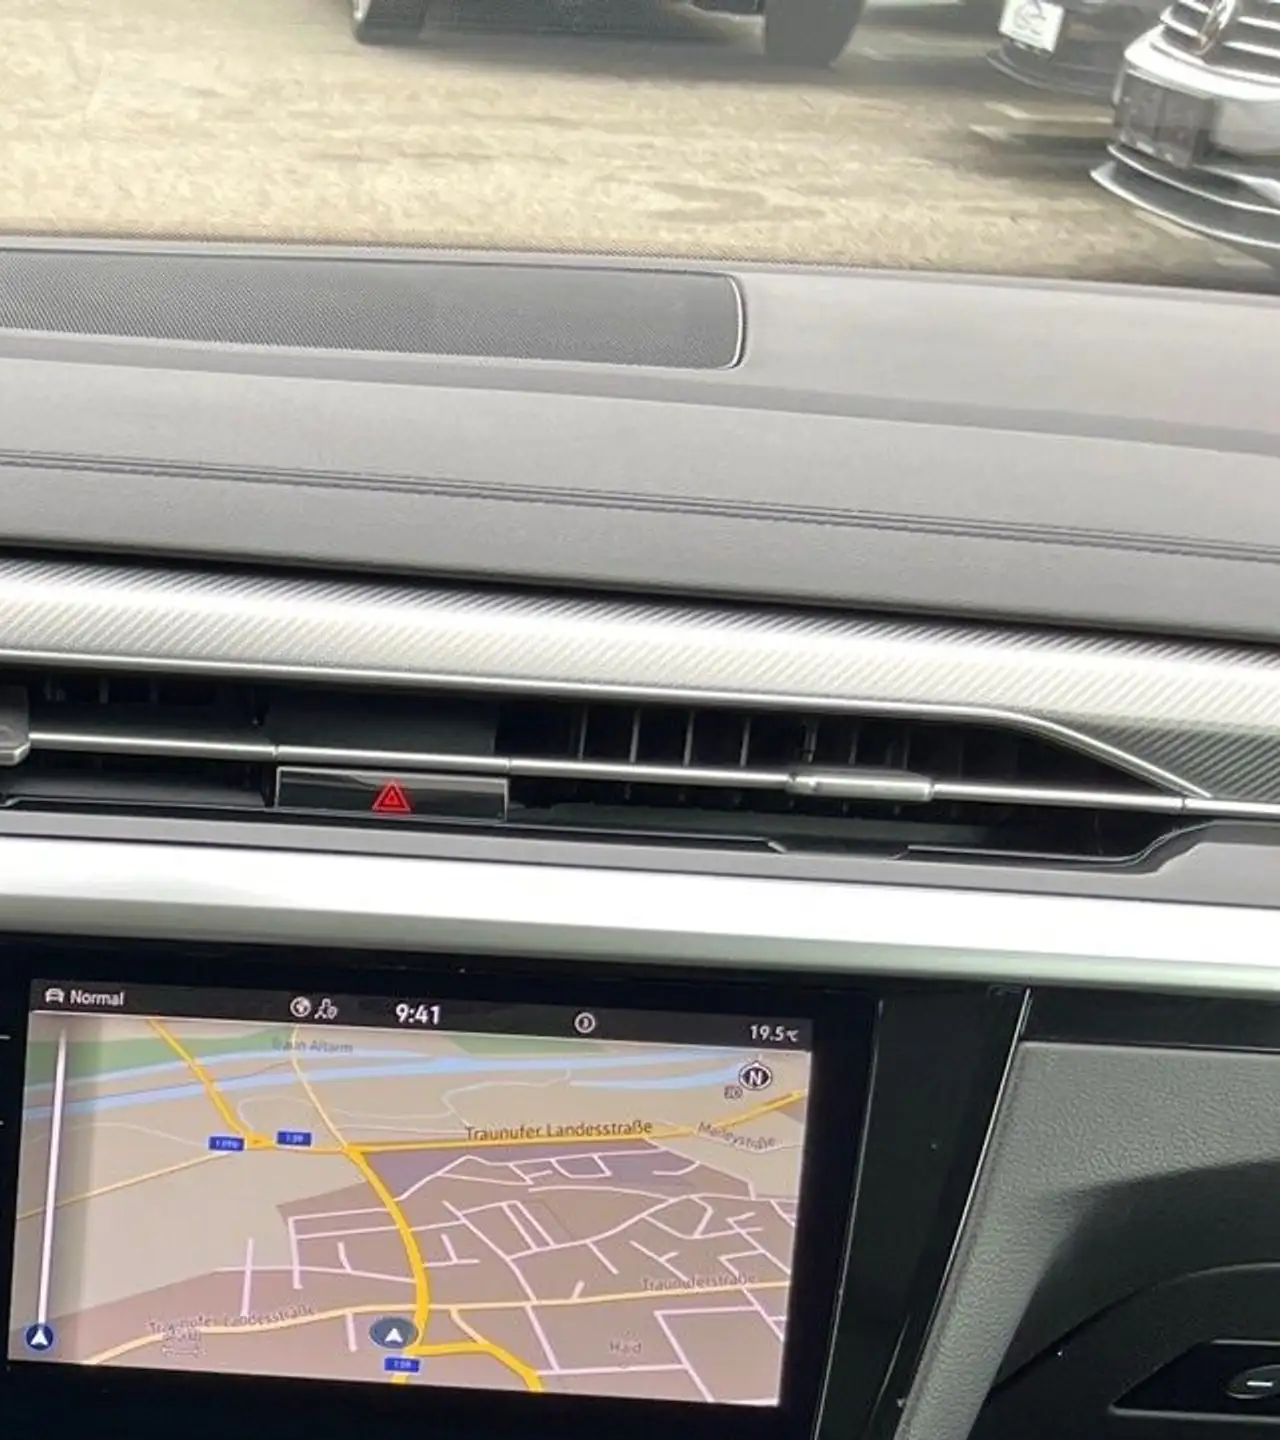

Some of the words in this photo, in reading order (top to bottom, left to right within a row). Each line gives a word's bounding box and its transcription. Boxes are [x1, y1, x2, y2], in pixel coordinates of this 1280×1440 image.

[70, 989, 125, 1007] Normal
[395, 1003, 440, 1026] 9:41
[748, 1069, 763, 1088] N
[465, 1121, 542, 1140] Traunufer
[546, 1118, 653, 1138] Landesstraße
